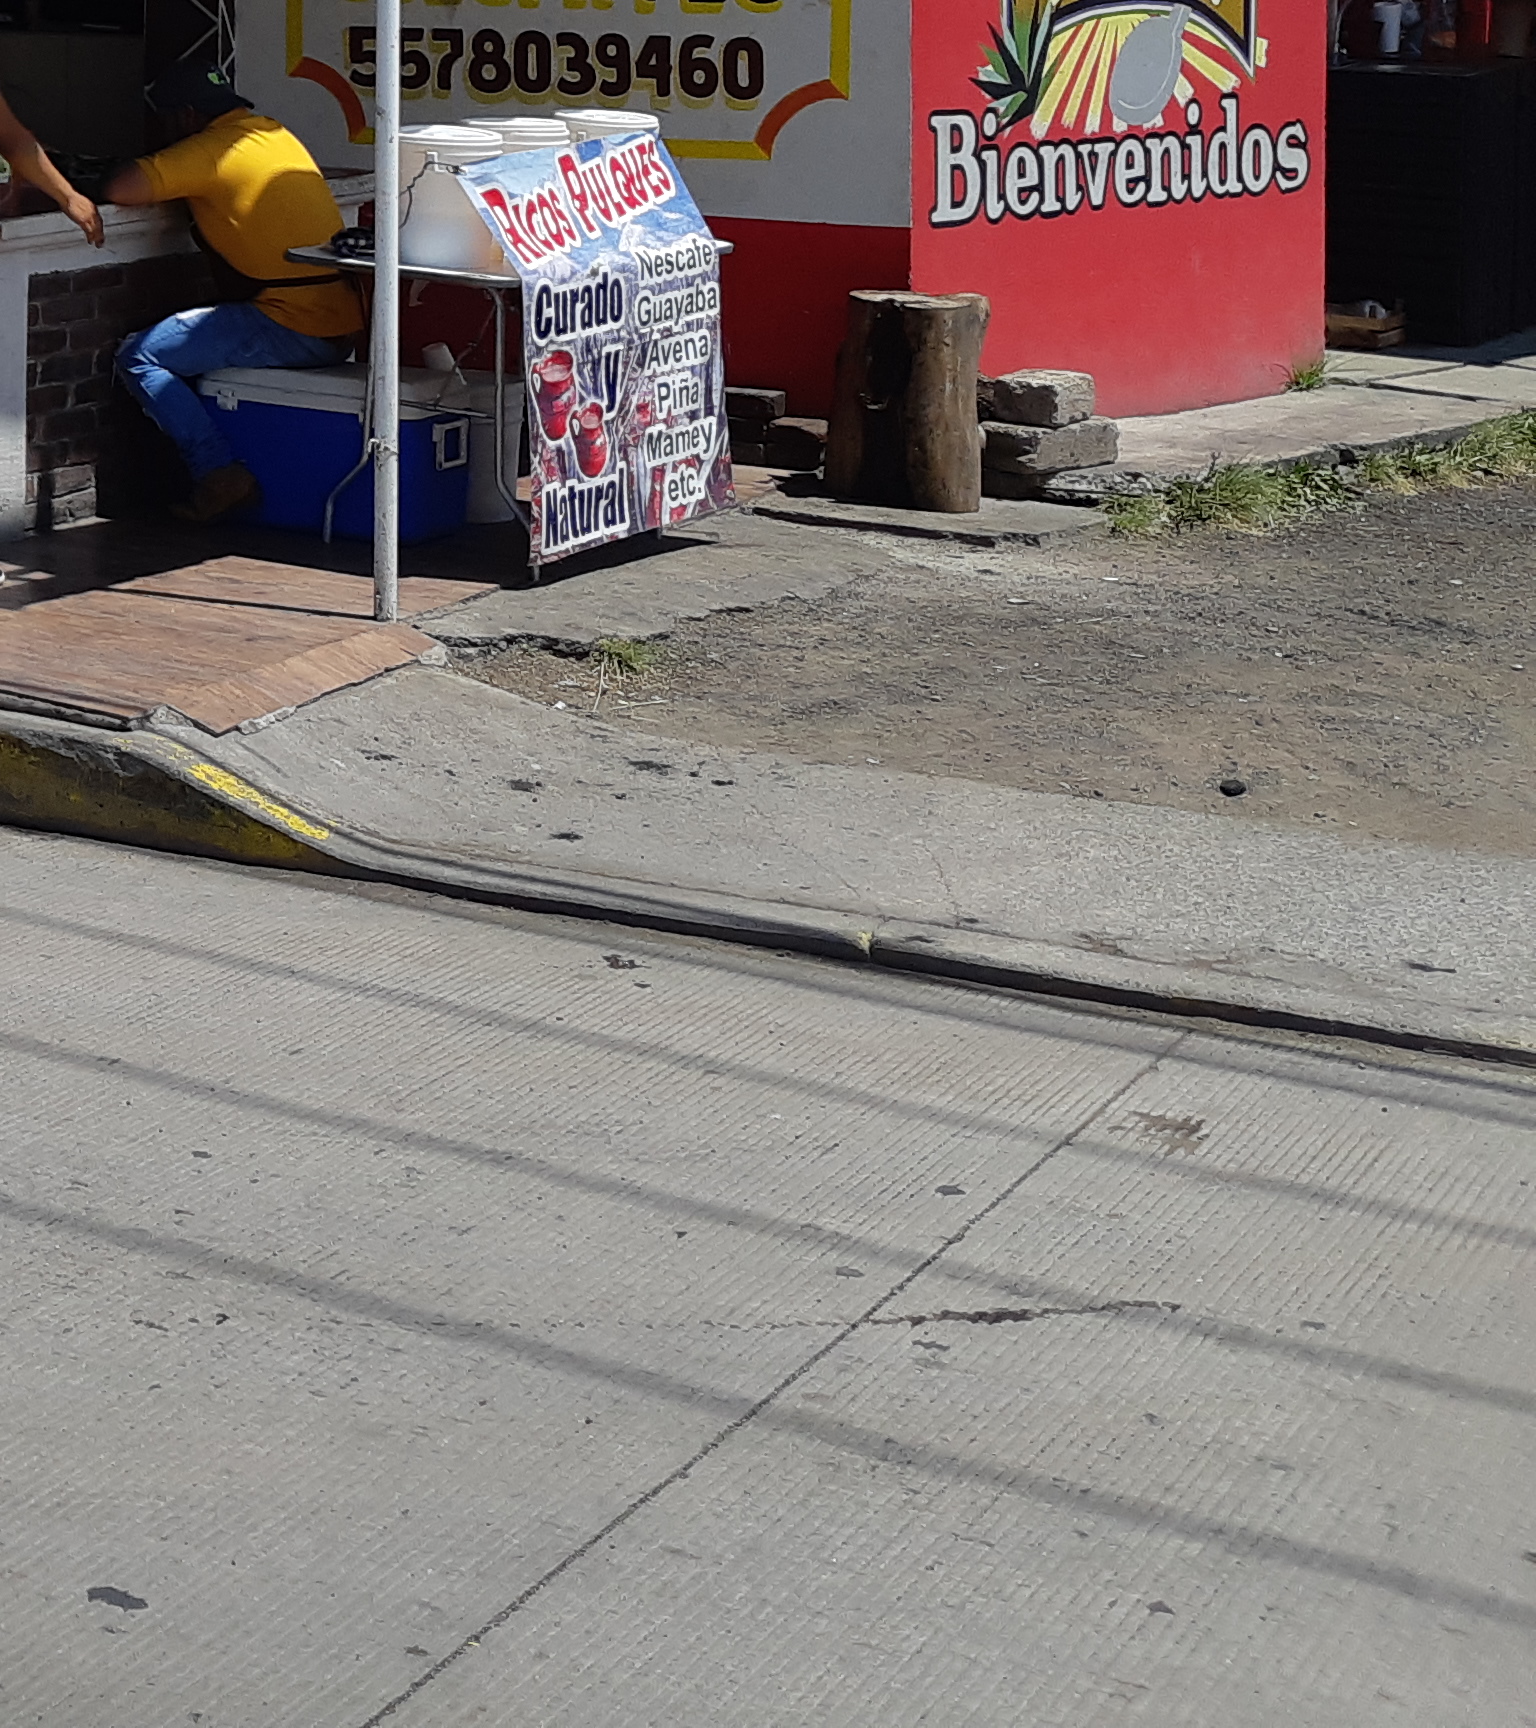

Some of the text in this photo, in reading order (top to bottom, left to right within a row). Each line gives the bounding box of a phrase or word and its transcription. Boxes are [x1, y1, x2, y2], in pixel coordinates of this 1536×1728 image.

[348, 26, 765, 101] 5578039460
[928, 92, 1310, 228] Bienvenidos
[534, 271, 623, 340] Curado
[637, 283, 718, 327] Guayaba
[647, 334, 709, 371] Avena
[604, 349, 621, 412] y
[656, 377, 700, 414] Piña
[646, 421, 713, 463] Mamey
[544, 467, 626, 550] Natural
[667, 469, 702, 502] etc.
